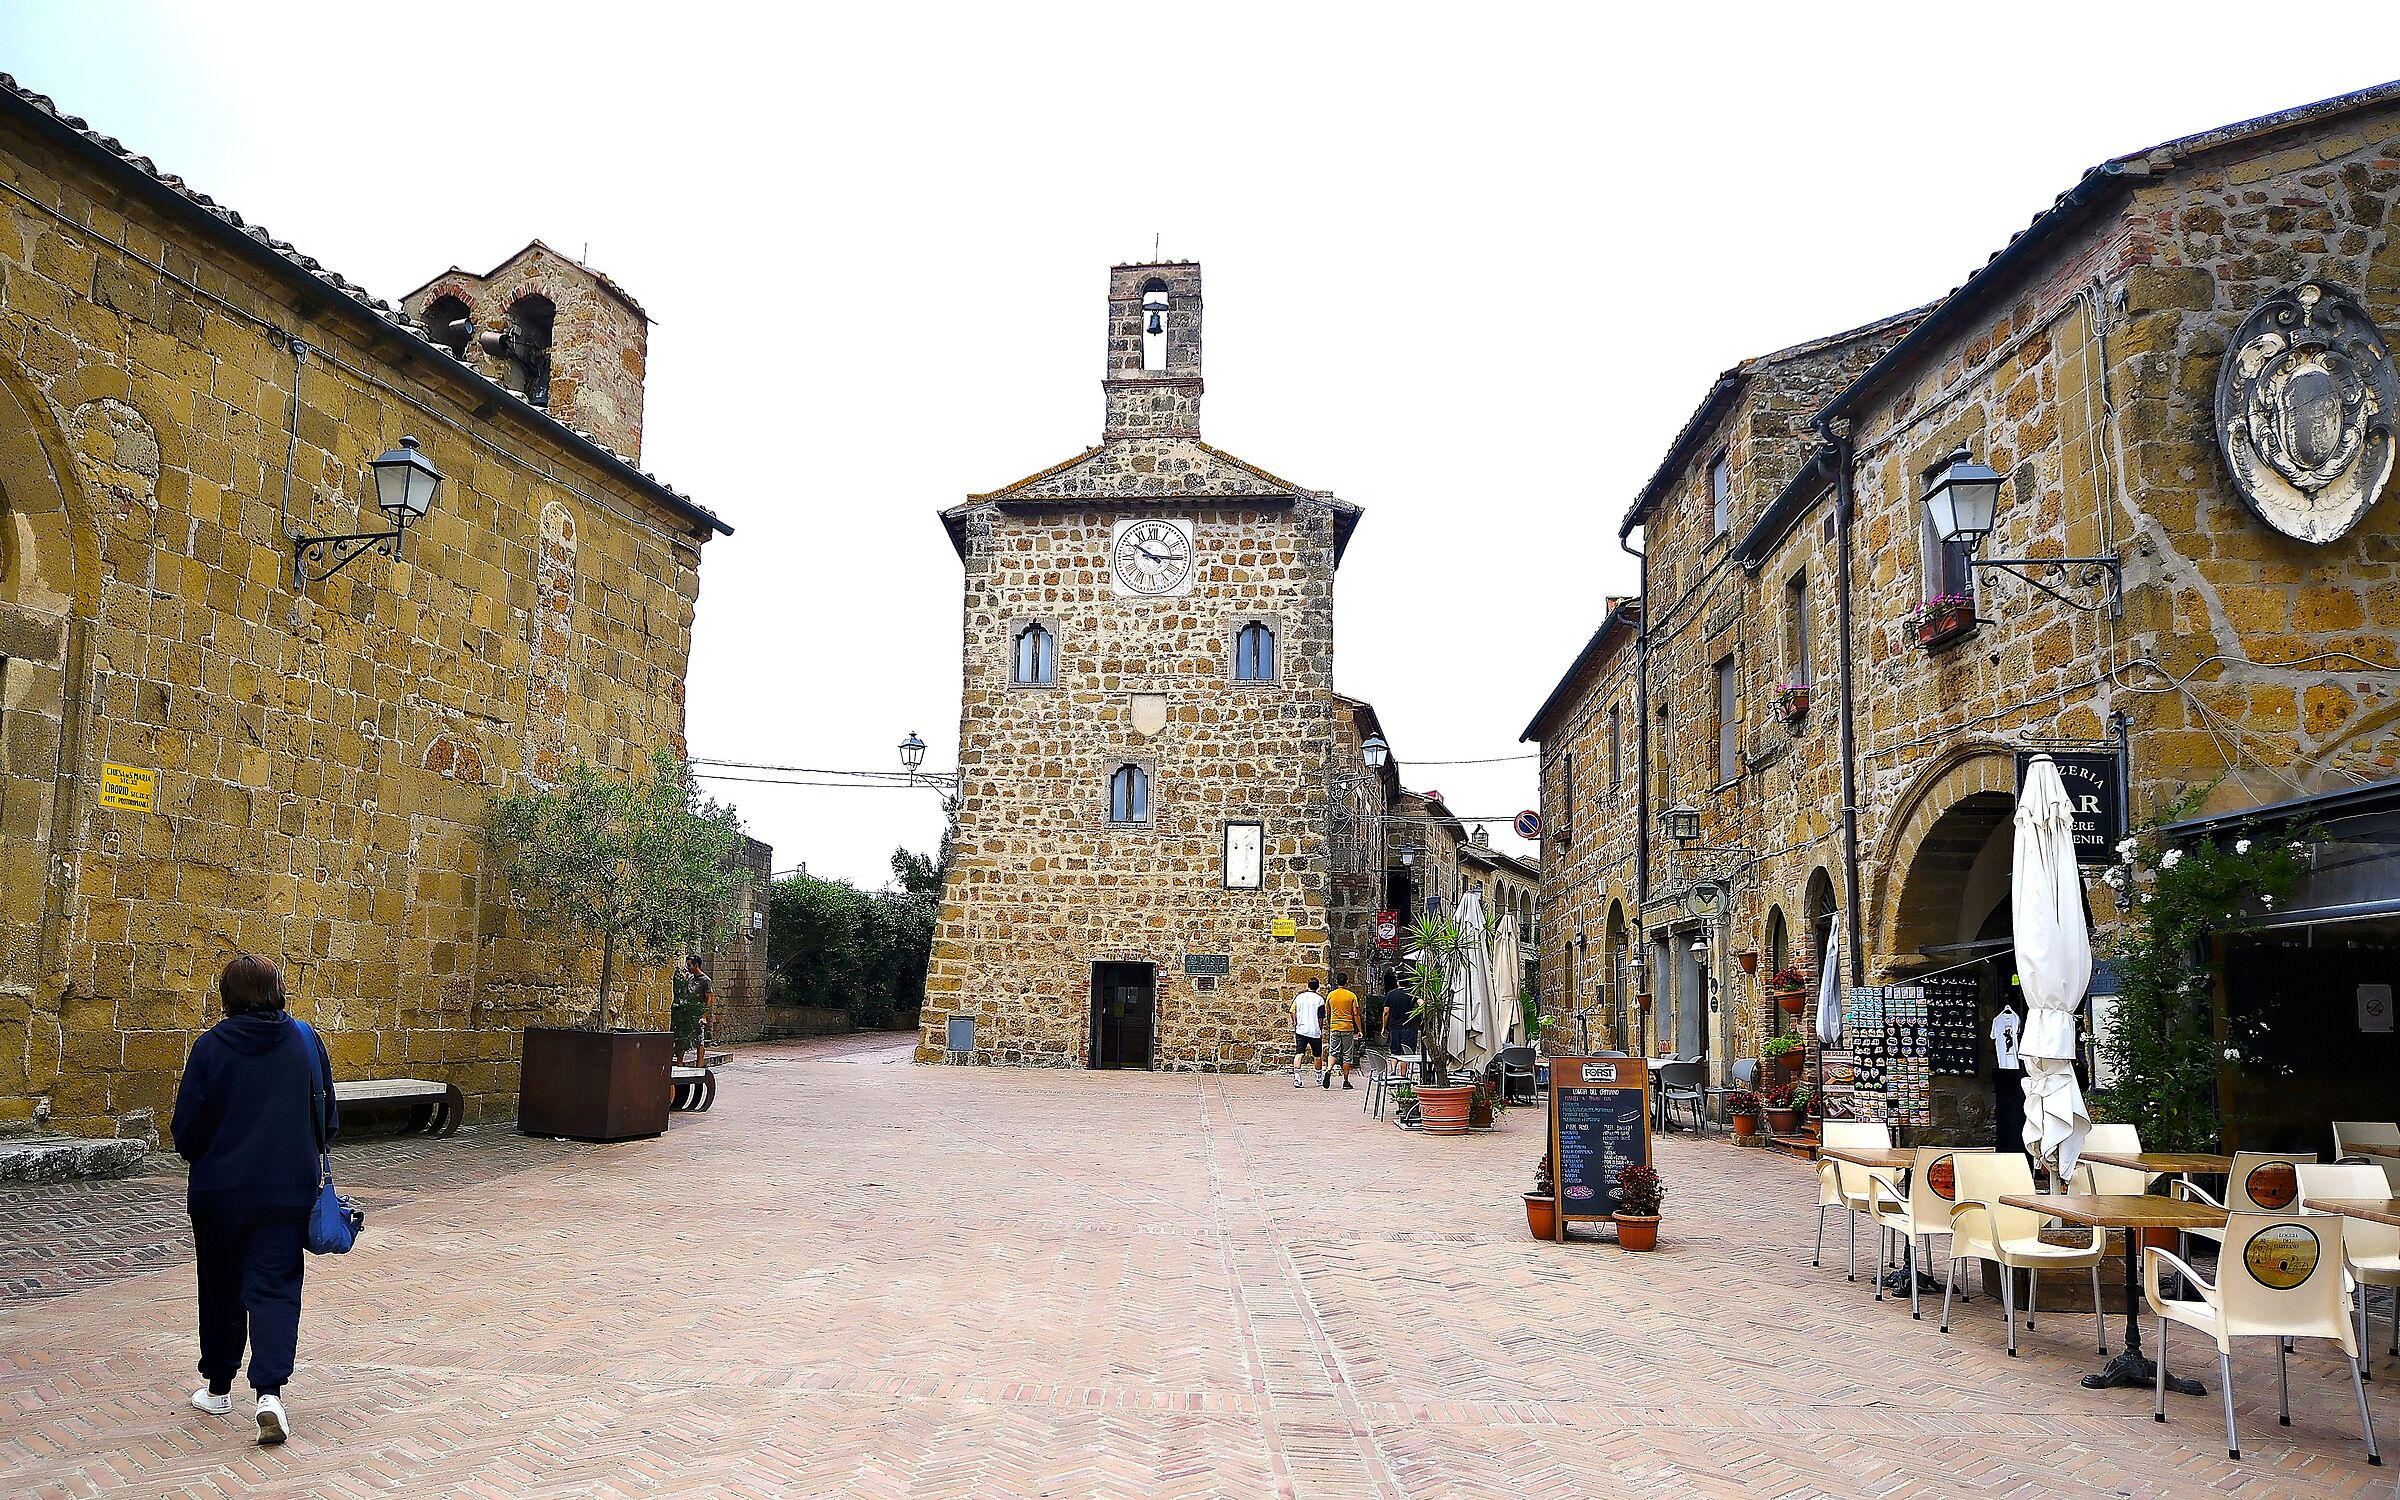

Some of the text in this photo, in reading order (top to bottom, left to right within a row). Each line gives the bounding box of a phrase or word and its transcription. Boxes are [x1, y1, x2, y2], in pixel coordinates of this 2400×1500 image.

[2057, 765, 2104, 790] ZERIA
[104, 781, 129, 796] CIBORIO
[2073, 834, 2104, 844] ENIR
[1585, 1068, 1614, 1078] FORST
